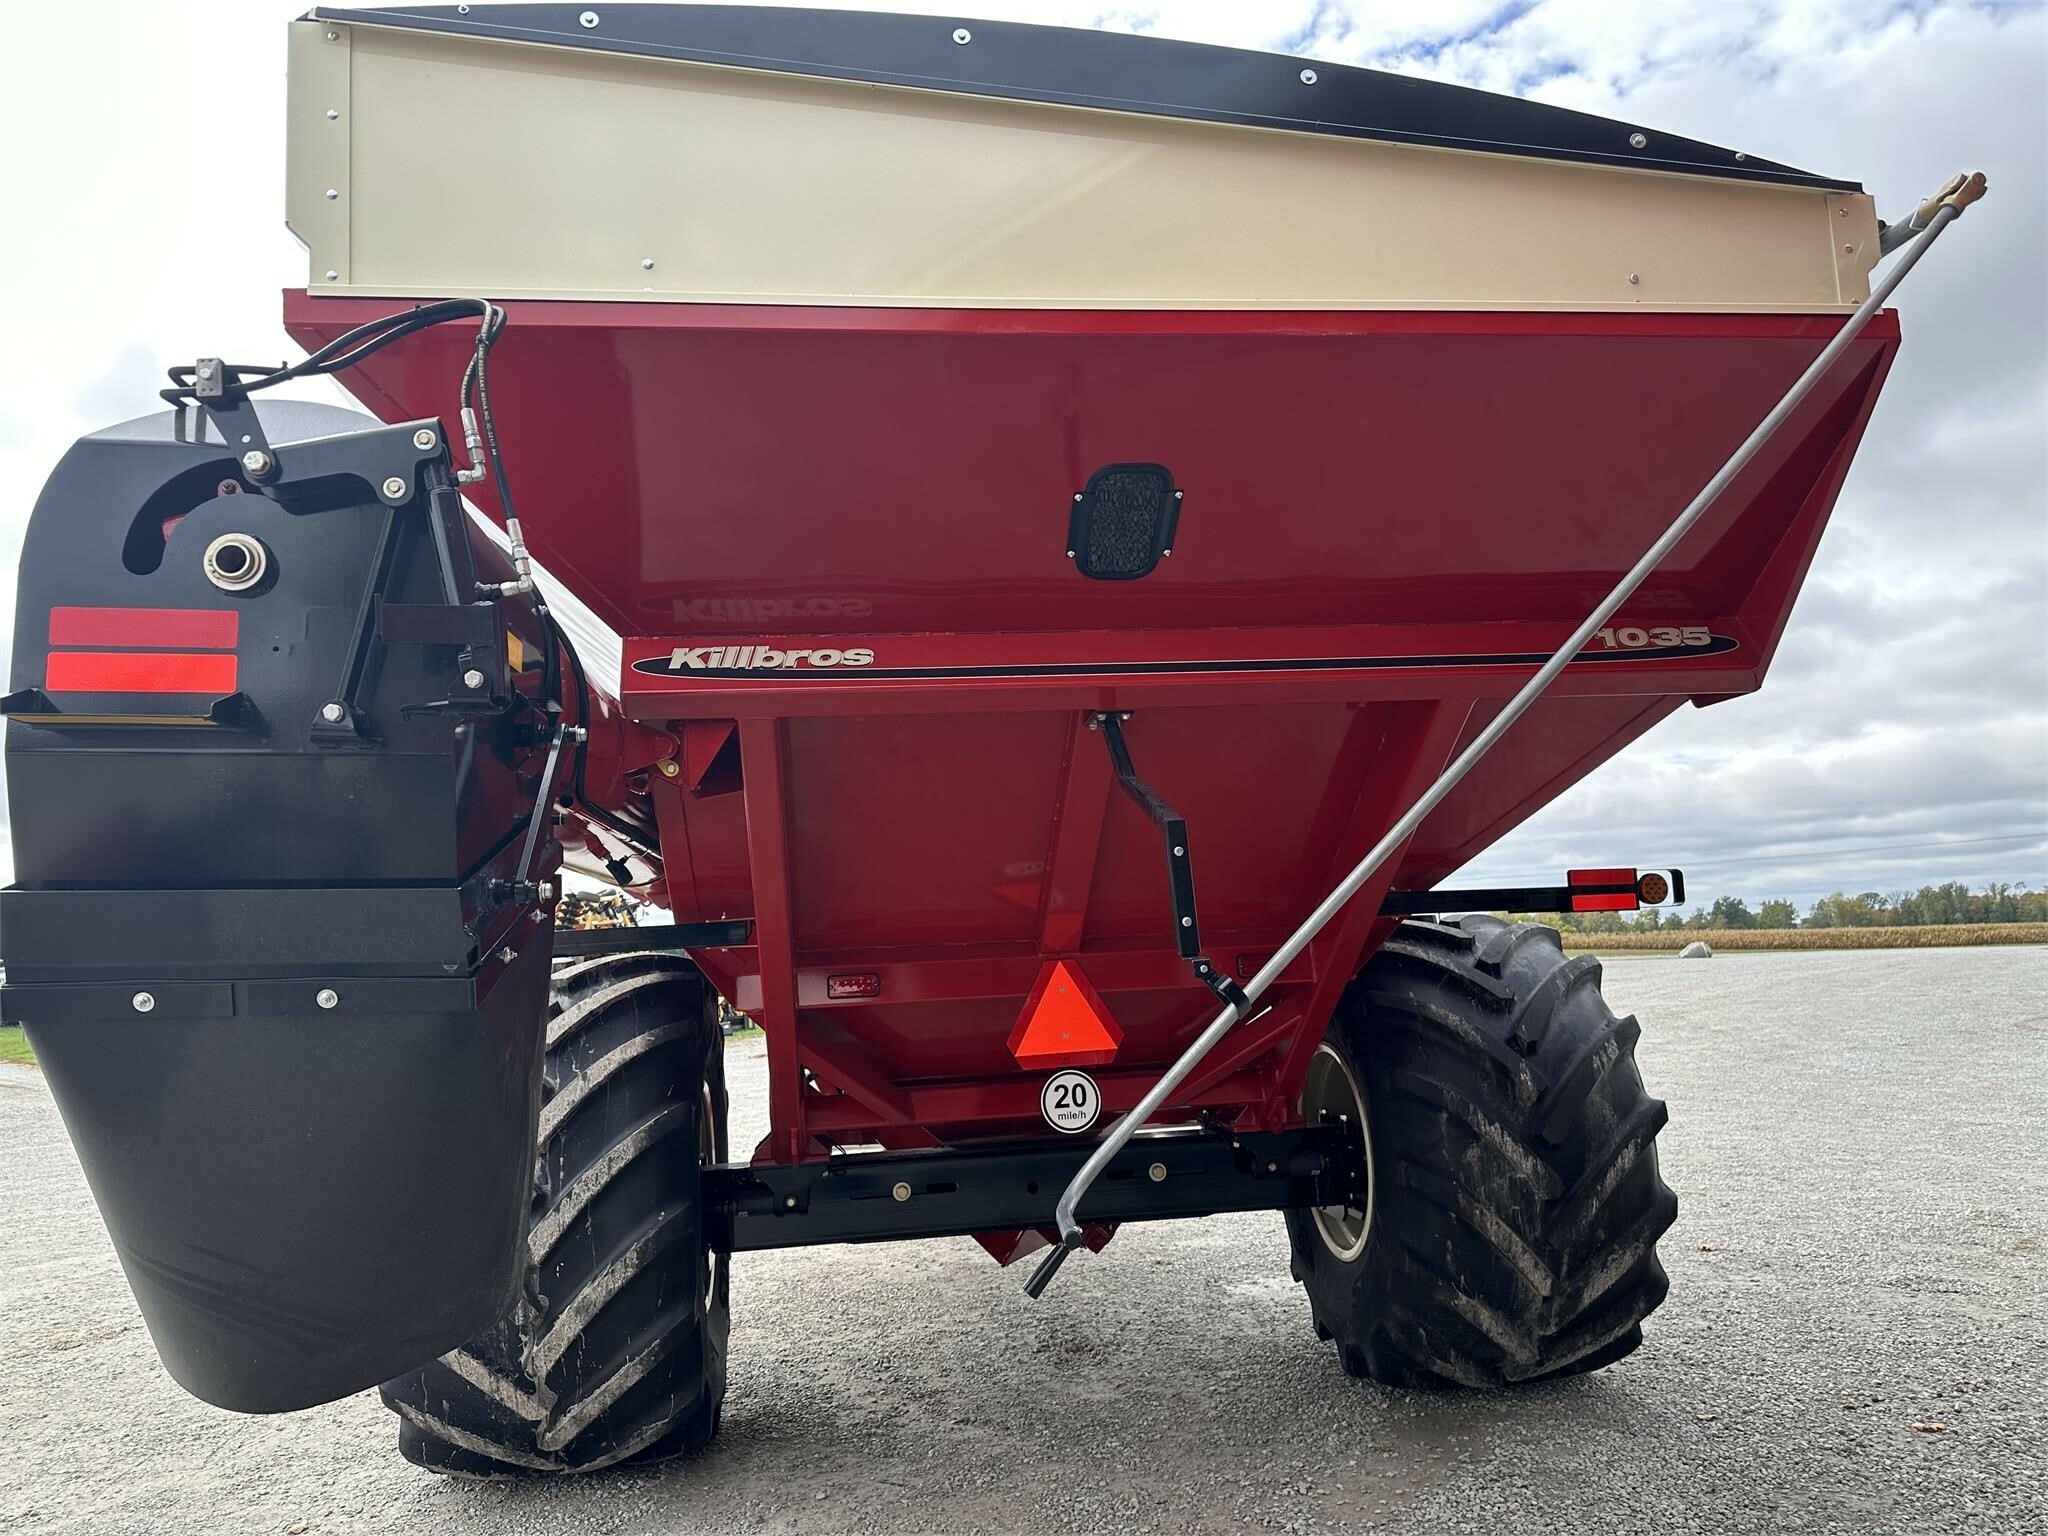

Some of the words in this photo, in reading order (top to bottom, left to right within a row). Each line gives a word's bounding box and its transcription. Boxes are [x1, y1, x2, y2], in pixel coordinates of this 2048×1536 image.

[1595, 627, 1712, 649] 1035
[668, 646, 874, 670] Killbros
[1054, 1083, 1087, 1109] 20
[1057, 1111, 1087, 1121] mile/h
